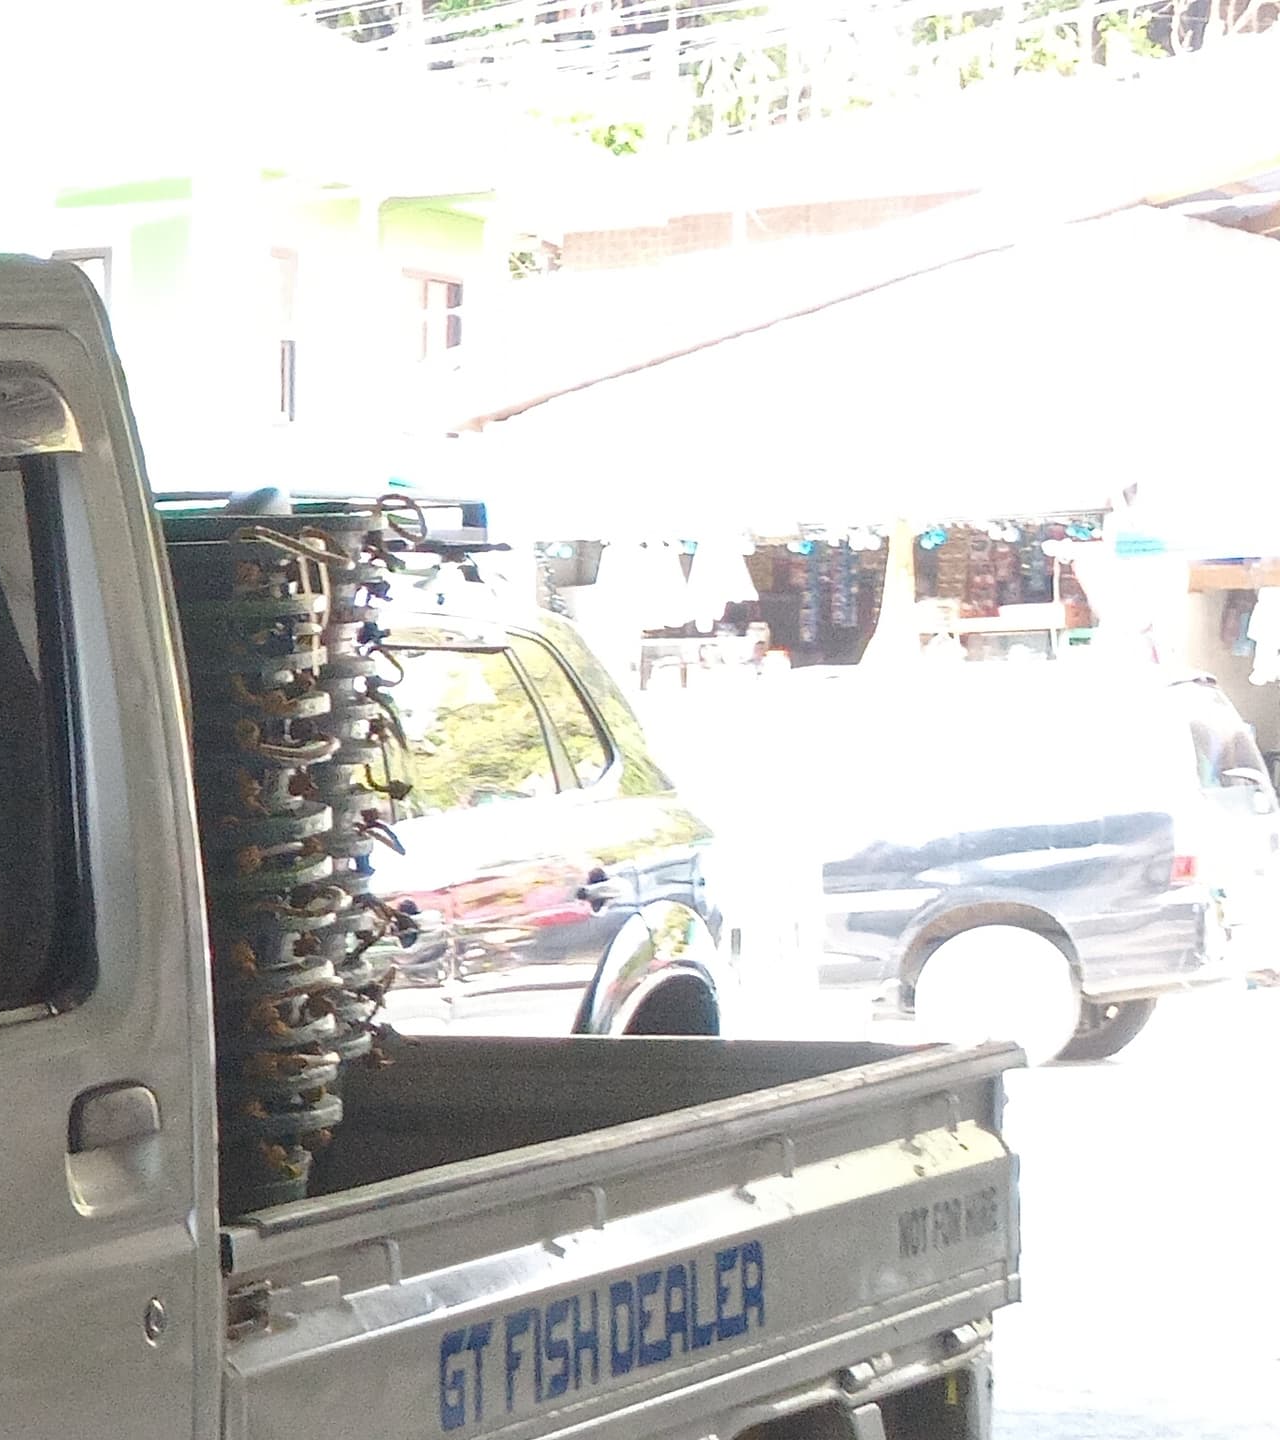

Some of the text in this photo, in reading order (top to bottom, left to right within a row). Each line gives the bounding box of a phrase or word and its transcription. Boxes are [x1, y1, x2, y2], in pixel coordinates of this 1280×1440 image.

[440, 1239, 767, 1432] GT FISH DEALER
